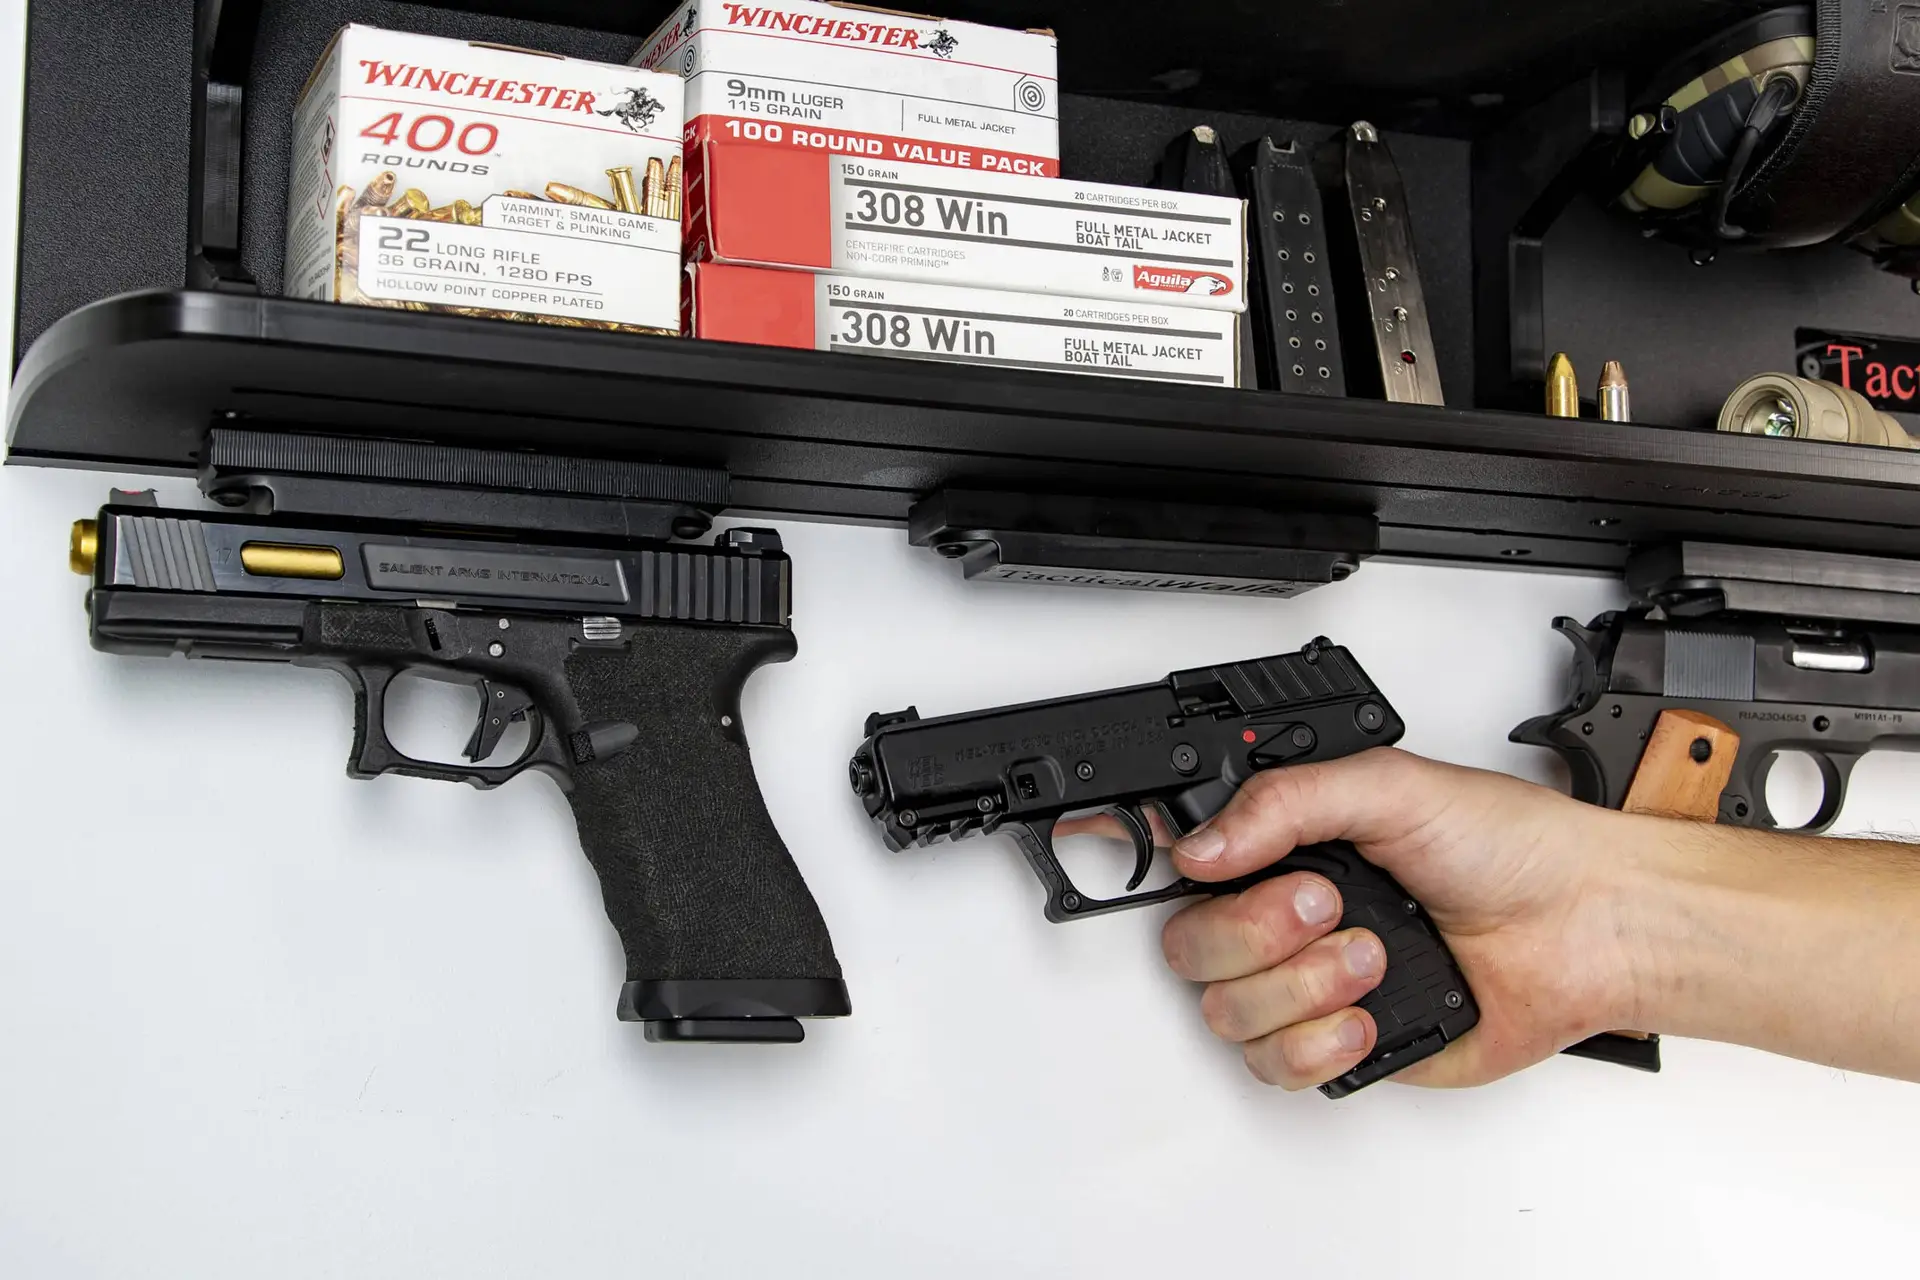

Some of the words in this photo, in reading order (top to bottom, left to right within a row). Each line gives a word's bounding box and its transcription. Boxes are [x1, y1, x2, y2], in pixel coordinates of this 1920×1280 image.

[722, 2, 920, 50] WINCHESTER
[359, 60, 596, 115] WINCHESTER
[727, 79, 786, 102] 9mm
[792, 92, 844, 110] LUGER
[728, 99, 760, 113] 115
[766, 103, 822, 120] GRAIN
[359, 112, 500, 156] 400
[918, 113, 942, 125] FULL
[945, 117, 977, 130] METAL
[980, 122, 1016, 135] JACKET
[725, 119, 783, 143] 100
[792, 129, 883, 154] ROUND
[893, 142, 972, 166] VALUE
[981, 153, 1045, 177] PACK
[361, 153, 490, 176] ROUNDS
[841, 163, 865, 176] 150
[868, 169, 899, 180] GRAIN
[1074, 191, 1085, 201] 20
[1086, 193, 1140, 207] CARTRIDGES
[1142, 198, 1159, 209] PER
[1161, 200, 1179, 210] BOX
[570, 211, 613, 226] SMALL
[845, 189, 925, 227] .308
[936, 197, 1008, 236] Win
[502, 214, 551, 229] TARGET
[556, 221, 565, 231] &
[570, 223, 631, 240] PLINKING
[1076, 220, 1110, 235] FULL
[1114, 224, 1158, 240] METAL
[1162, 230, 1212, 245] JACKET
[378, 225, 430, 253] 22
[437, 242, 486, 259] LONG
[493, 249, 541, 265] RIFLE
[846, 239, 904, 253] CENTERFIRE
[907, 246, 967, 260] CARTRIDGES
[1076, 232, 1111, 247] BOAT
[1114, 236, 1144, 250] TAIL
[846, 251, 898, 264] NON-CORR
[378, 253, 404, 267] 36
[497, 265, 548, 282] 1280
[555, 271, 593, 287] FPS
[1136, 270, 1192, 287] Aguila
[376, 277, 438, 293] HOLLOW
[444, 284, 487, 297] POINT
[492, 289, 548, 304] COPPER
[553, 295, 604, 311] PLATED
[827, 284, 851, 297] 150
[853, 289, 885, 300] GRAIN
[1063, 308, 1074, 317] 20
[1075, 309, 1131, 323] CARTRIDGES
[1132, 314, 1150, 324] PER
[1151, 316, 1169, 326] BOX
[830, 310, 911, 349] .308
[922, 317, 995, 356] Win
[1064, 338, 1099, 352] FULL
[1103, 341, 1148, 357] METAL
[1152, 346, 1203, 361] JACKET
[1065, 351, 1099, 364] BOAT
[1103, 353, 1133, 367] TAIL
[378, 562, 443, 576] SALIENT
[448, 567, 491, 580] ARMS
[497, 568, 611, 588] INTERNATIONAL
